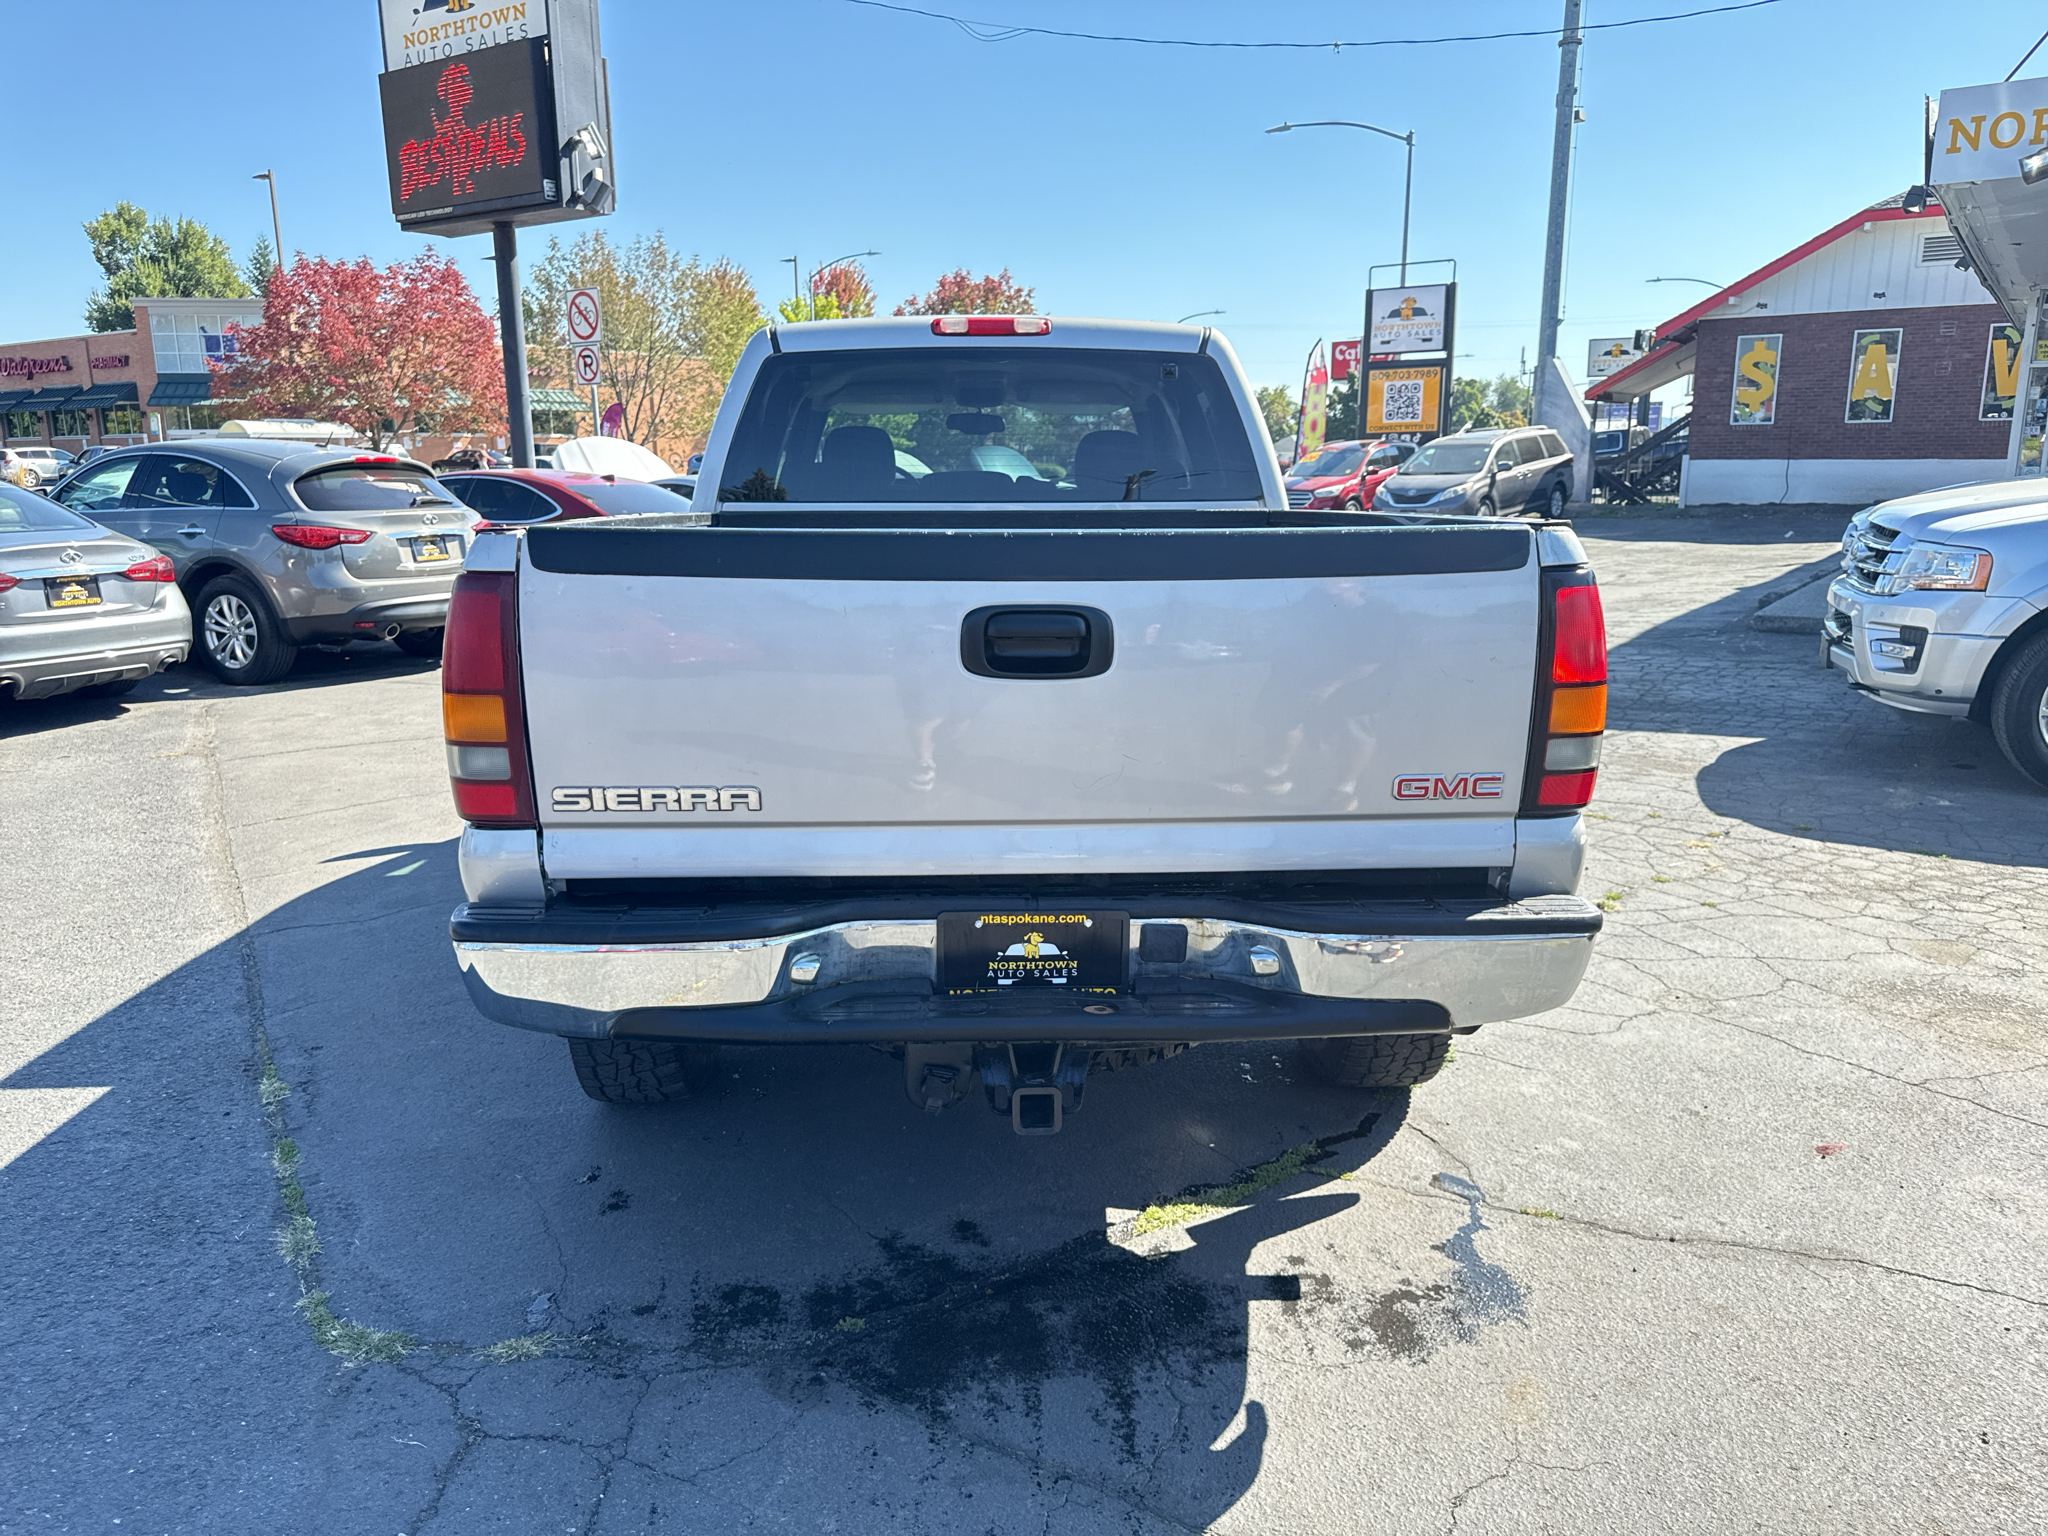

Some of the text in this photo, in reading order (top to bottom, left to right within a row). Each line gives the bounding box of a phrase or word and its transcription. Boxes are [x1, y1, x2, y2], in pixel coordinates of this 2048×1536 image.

[402, 2, 527, 49] NORTHTOWN
[404, 23, 529, 68] AUTO SALES
[1373, 321, 1442, 332] NORTHTOWN
[1372, 329, 1442, 339] AUTO SALES
[0, 357, 67, 379] Walgreens
[91, 355, 126, 370] PHARMACY
[1369, 422, 1436, 432] CONNECT WITH US
[1391, 772, 1504, 800] GMC
[551, 785, 762, 811] SIERRA
[980, 913, 1087, 926] ntaspokane.com
[988, 960, 1078, 970] NORTHTOWN
[986, 968, 1078, 978] AUTO SALES
